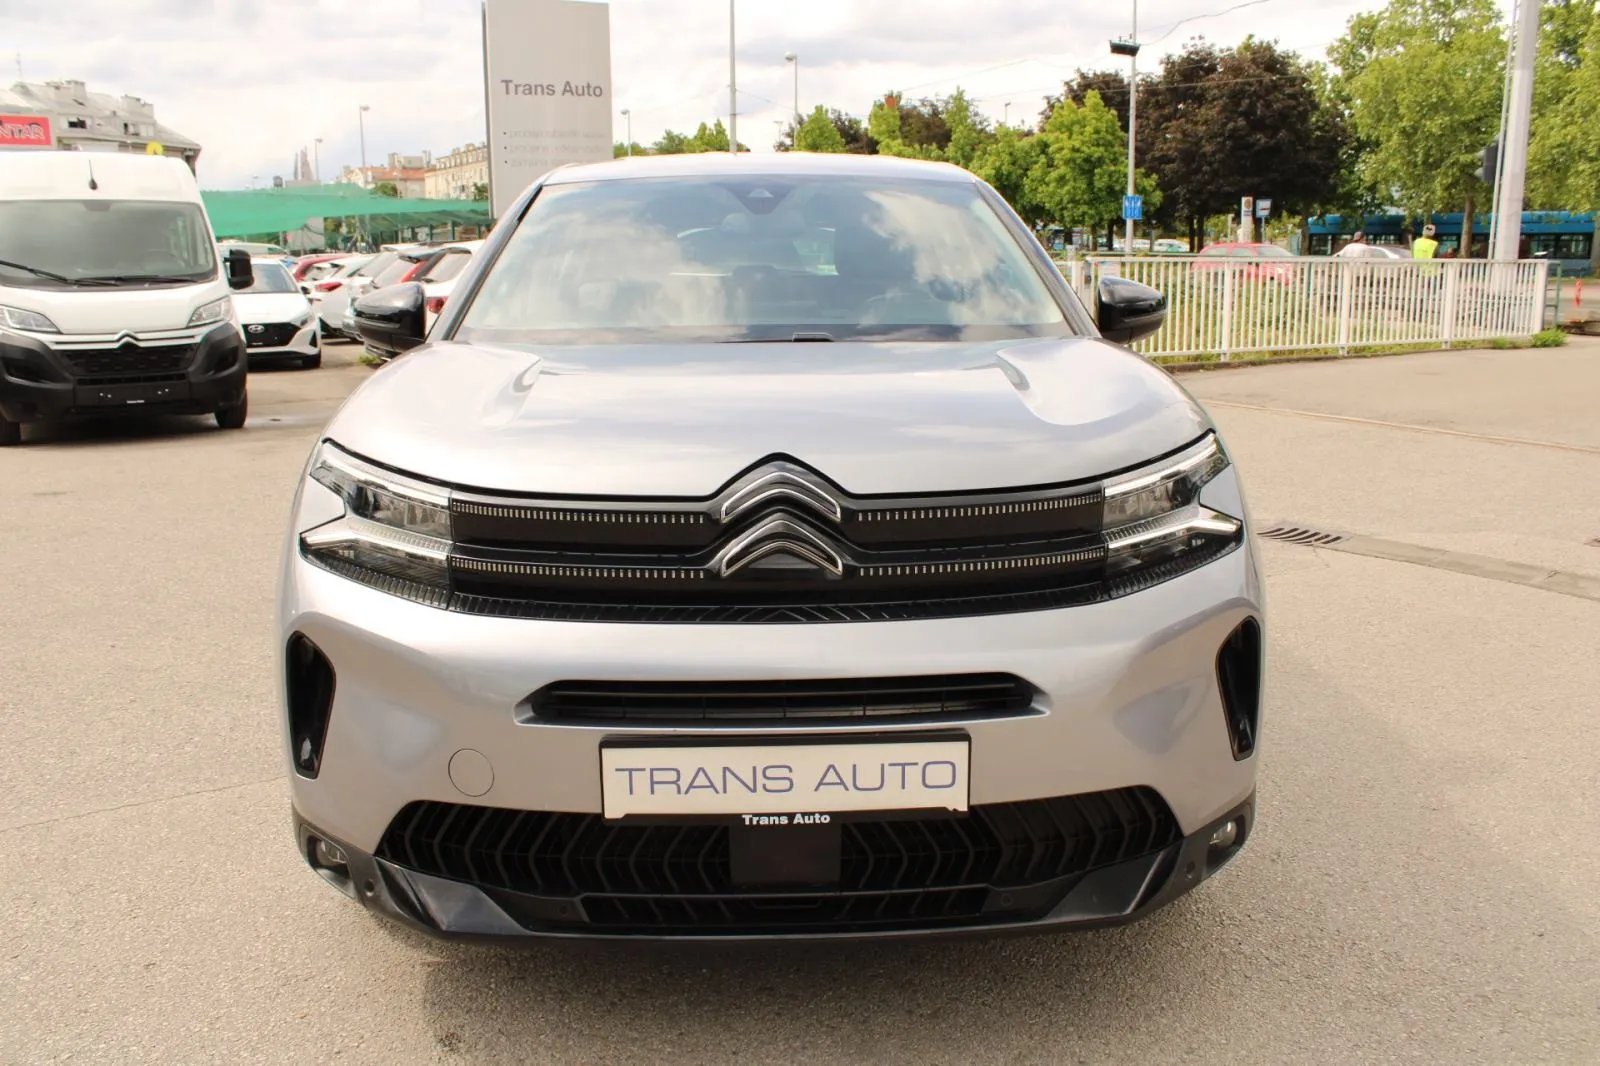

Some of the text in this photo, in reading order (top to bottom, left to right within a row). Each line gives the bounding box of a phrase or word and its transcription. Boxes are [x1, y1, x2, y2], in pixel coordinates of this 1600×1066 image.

[500, 79, 603, 97] Trans Auto
[615, 760, 956, 795] TRANS AUTO
[742, 813, 831, 825] Trans Auto
